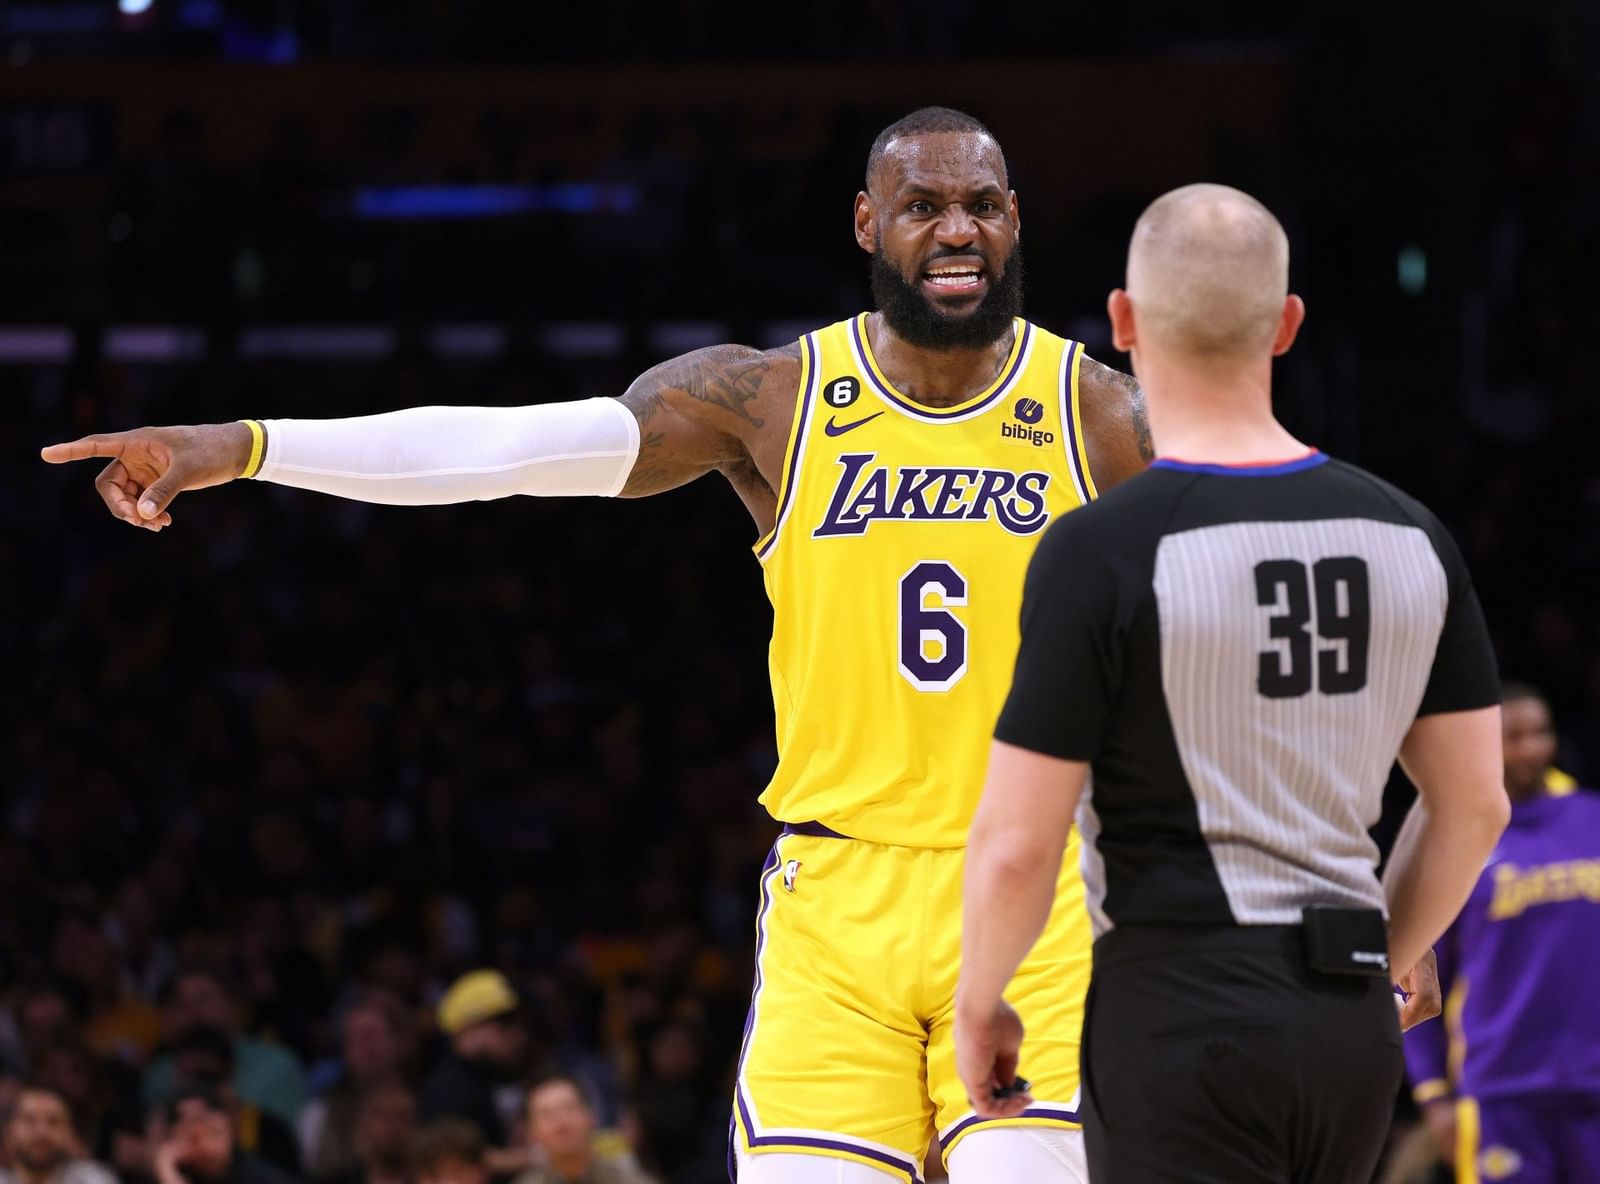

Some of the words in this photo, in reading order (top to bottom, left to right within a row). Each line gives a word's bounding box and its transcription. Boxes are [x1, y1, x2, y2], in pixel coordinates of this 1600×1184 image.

[833, 380, 852, 405] 6
[1001, 422, 1055, 447] bibigo
[812, 452, 1052, 538] LAKERS
[898, 560, 968, 693] 6
[1254, 556, 1371, 699] 39
